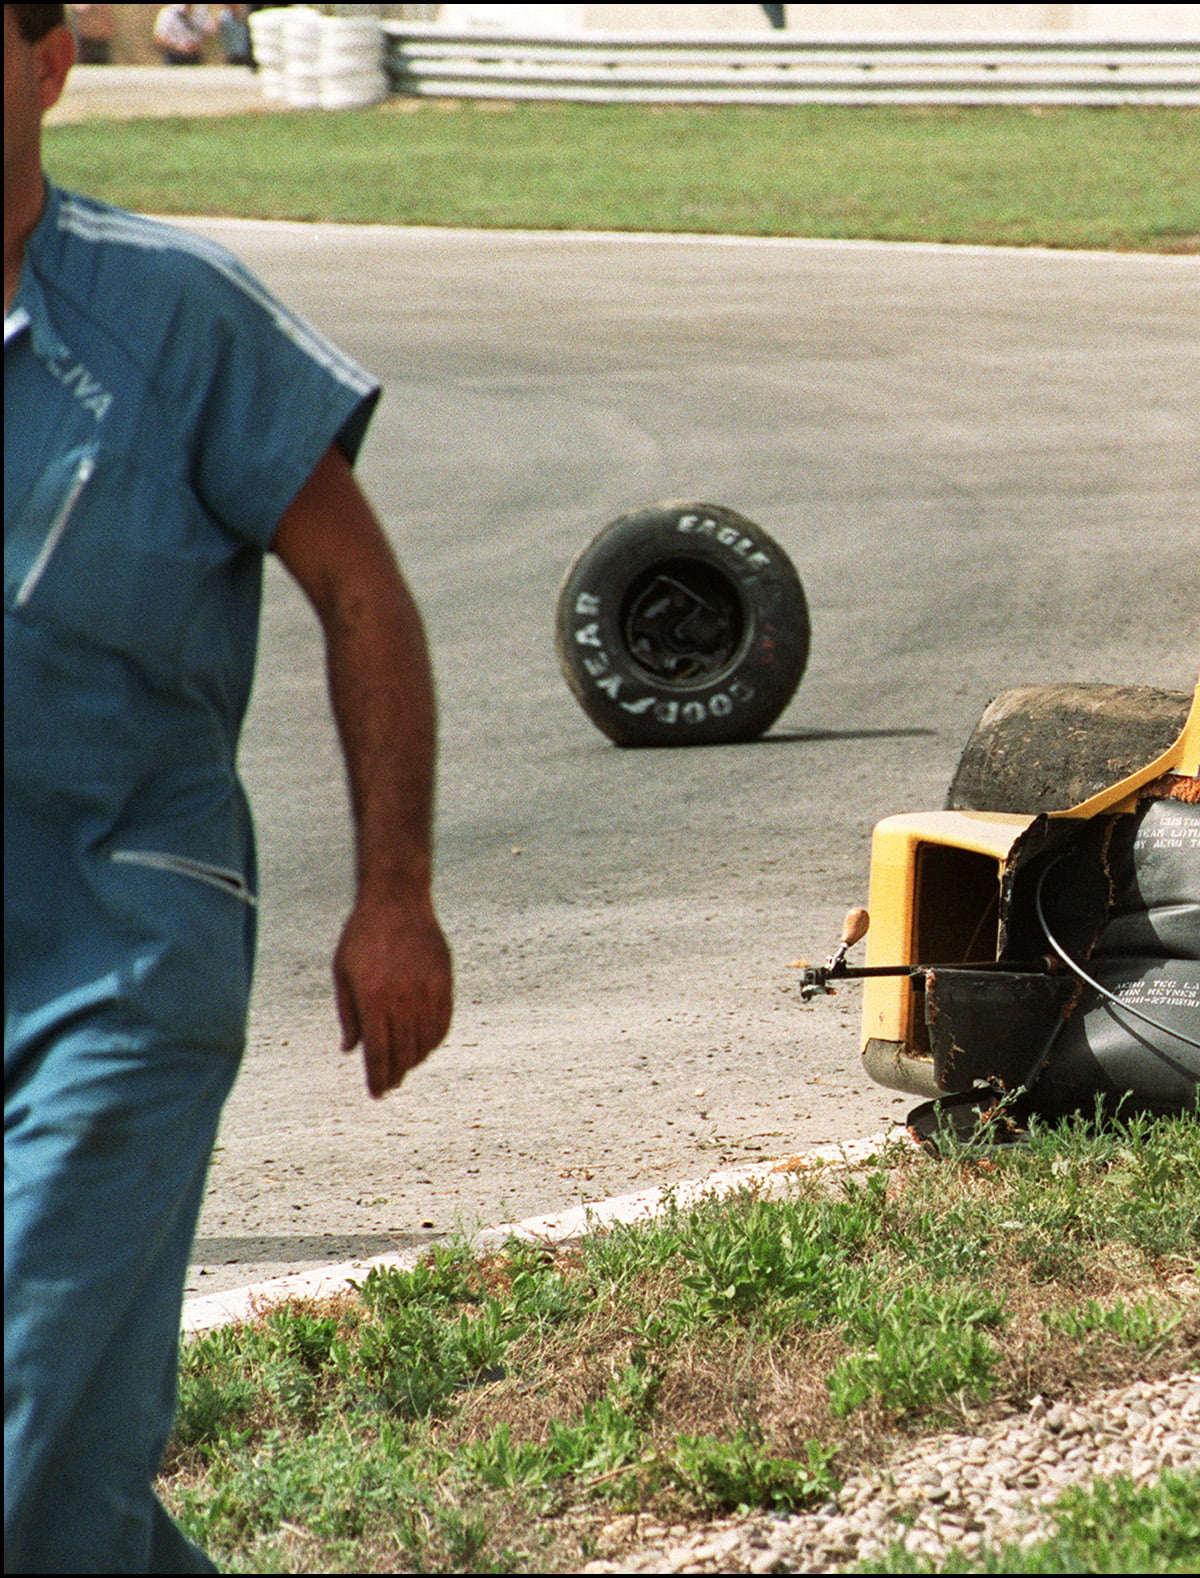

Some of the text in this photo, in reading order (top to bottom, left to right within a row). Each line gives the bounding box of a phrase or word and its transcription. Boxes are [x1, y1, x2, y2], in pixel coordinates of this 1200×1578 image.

[677, 515, 770, 568] EAGLE
[575, 592, 755, 724] GOODYEAR
[1137, 828, 1164, 839] TEAM
[1133, 840, 1147, 850] BY
[1153, 838, 1183, 849] AERO
[1153, 980, 1177, 989] TEC
[1146, 988, 1197, 998] KEYNES
